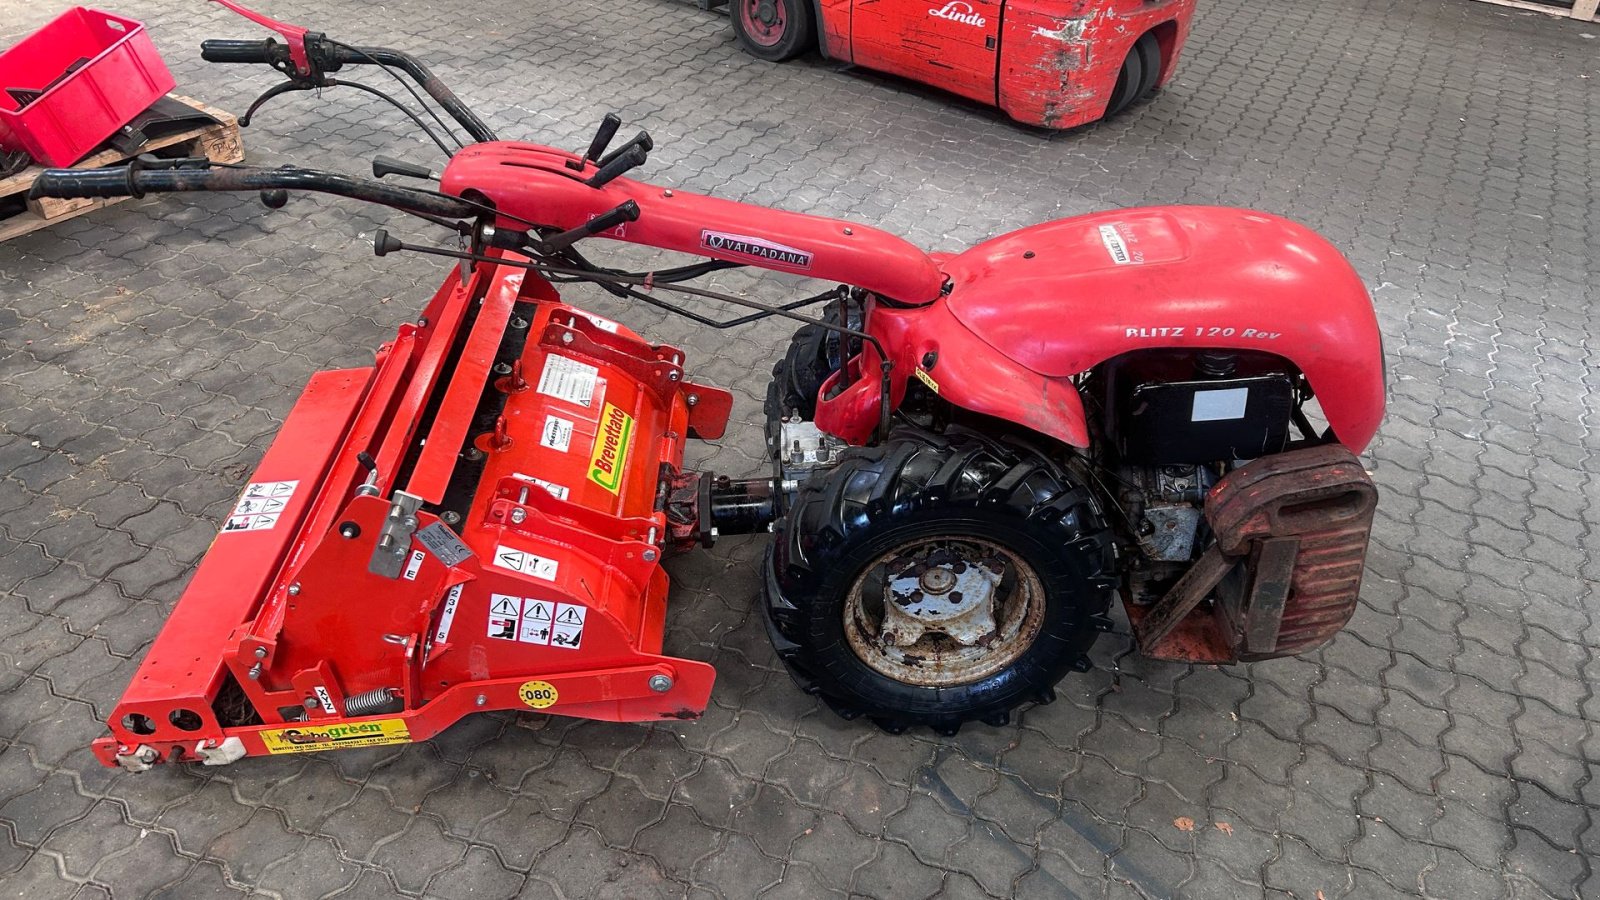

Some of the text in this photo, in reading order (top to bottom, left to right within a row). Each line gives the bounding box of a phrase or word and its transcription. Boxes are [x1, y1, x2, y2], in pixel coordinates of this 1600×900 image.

[928, 0, 986, 28] Linde
[726, 239, 805, 266] VALPADANA
[1126, 326, 1282, 340] BLITZ 120 Rev
[595, 407, 625, 475] Brevettato
[414, 552, 424, 561] S
[406, 570, 416, 579] E
[525, 689, 551, 700] 080
